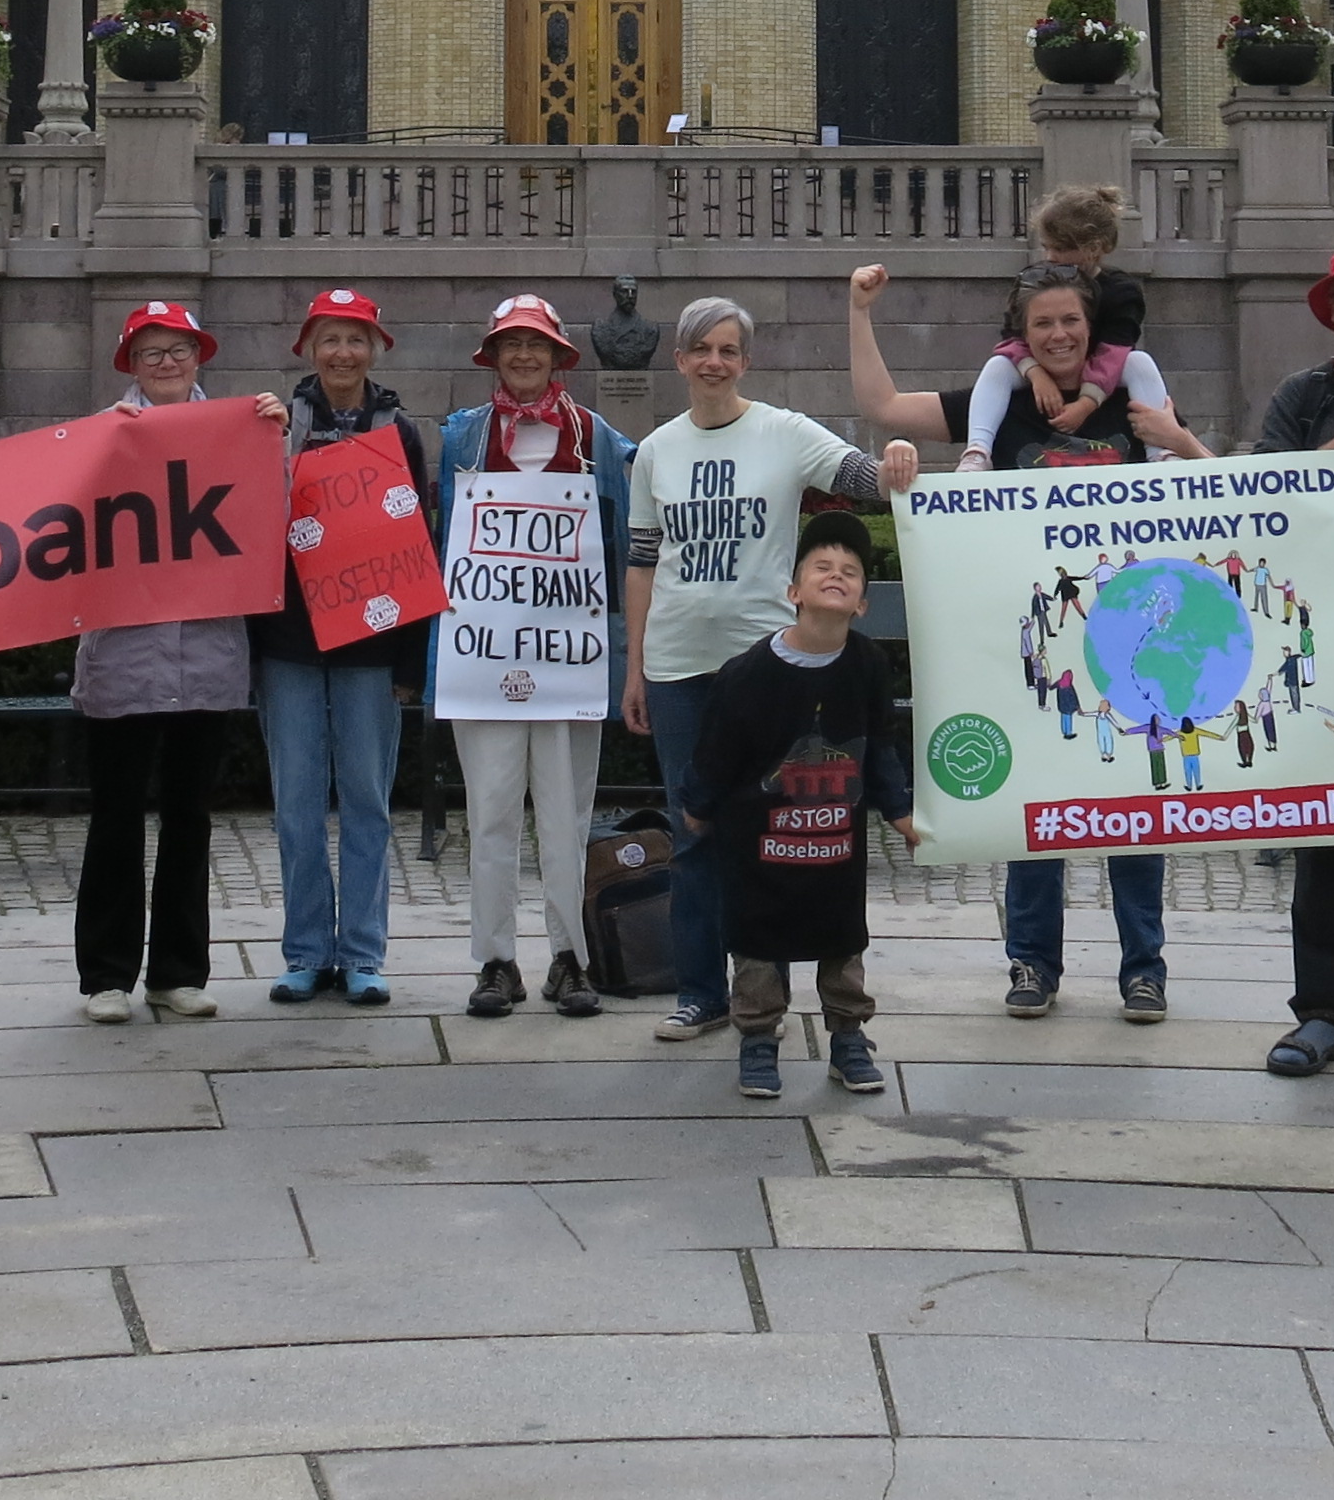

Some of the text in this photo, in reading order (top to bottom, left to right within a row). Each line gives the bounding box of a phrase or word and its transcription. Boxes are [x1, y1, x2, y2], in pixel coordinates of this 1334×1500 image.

[299, 467, 379, 518] STOP
[690, 459, 736, 499] FOR
[910, 486, 1038, 515] PARENTS
[1045, 478, 1166, 510] ACROSS
[1171, 474, 1225, 500] THE
[481, 508, 575, 554] STOP
[663, 497, 767, 543] FUTURE'S
[1044, 512, 1289, 550] FOR NORWAY TO
[302, 540, 437, 615] ROSEBANK
[680, 540, 741, 582] SAKE
[449, 557, 605, 608] ROSEBANK
[454, 624, 604, 665] OIL FIELD
[932, 718, 1007, 760] PARENTS FOR FUTURE
[962, 784, 981, 796] UK
[1034, 804, 1153, 843] #Stop
[764, 838, 851, 858] Rosebank
